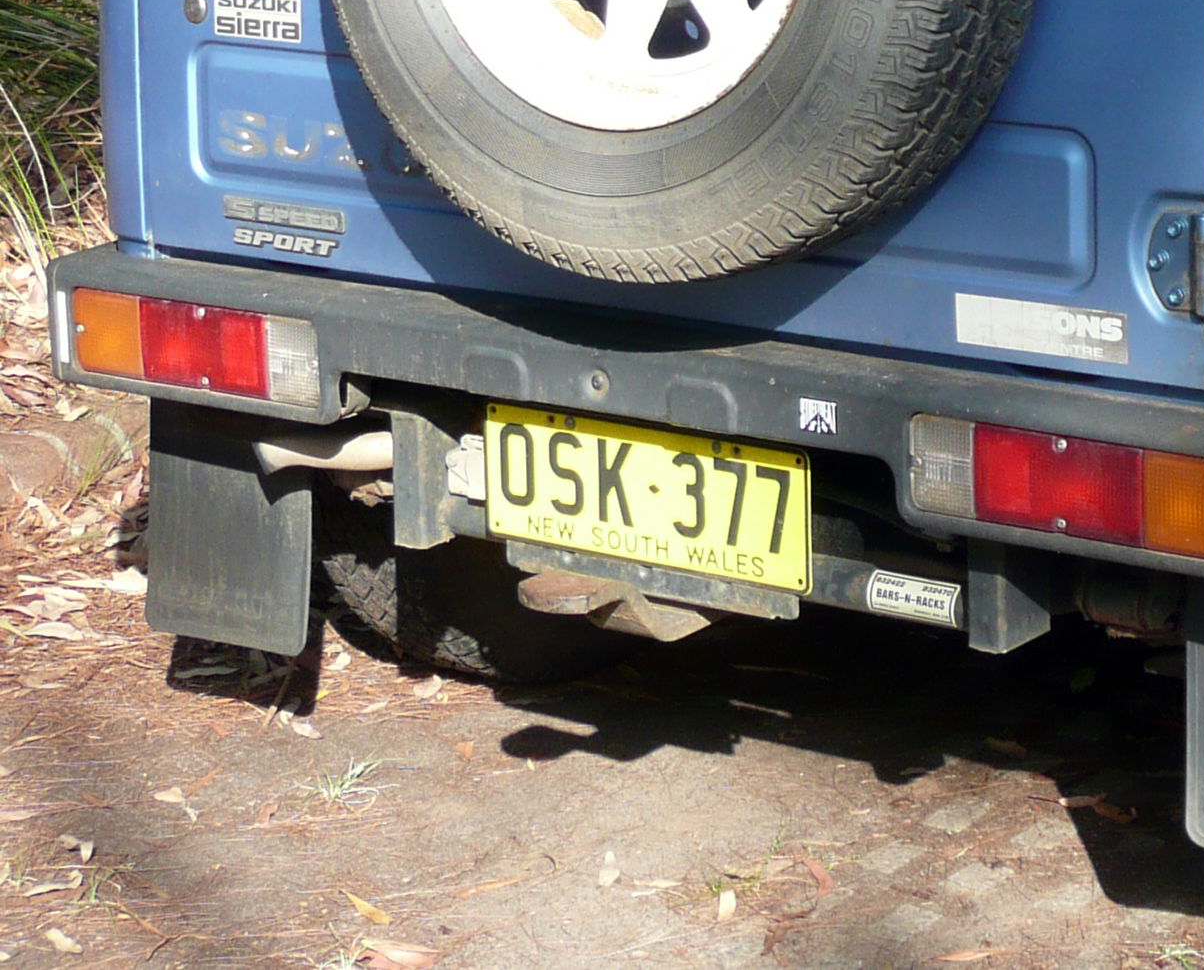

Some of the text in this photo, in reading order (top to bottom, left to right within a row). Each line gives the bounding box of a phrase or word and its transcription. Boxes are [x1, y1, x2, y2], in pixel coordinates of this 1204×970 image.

[216, 12, 300, 41] sierra
[257, 206, 339, 230] SPEED
[233, 228, 338, 257] SPORT
[527, 515, 765, 578] NEW SOUTH WALES
[876, 588, 946, 611] BARS-N-RACKS
